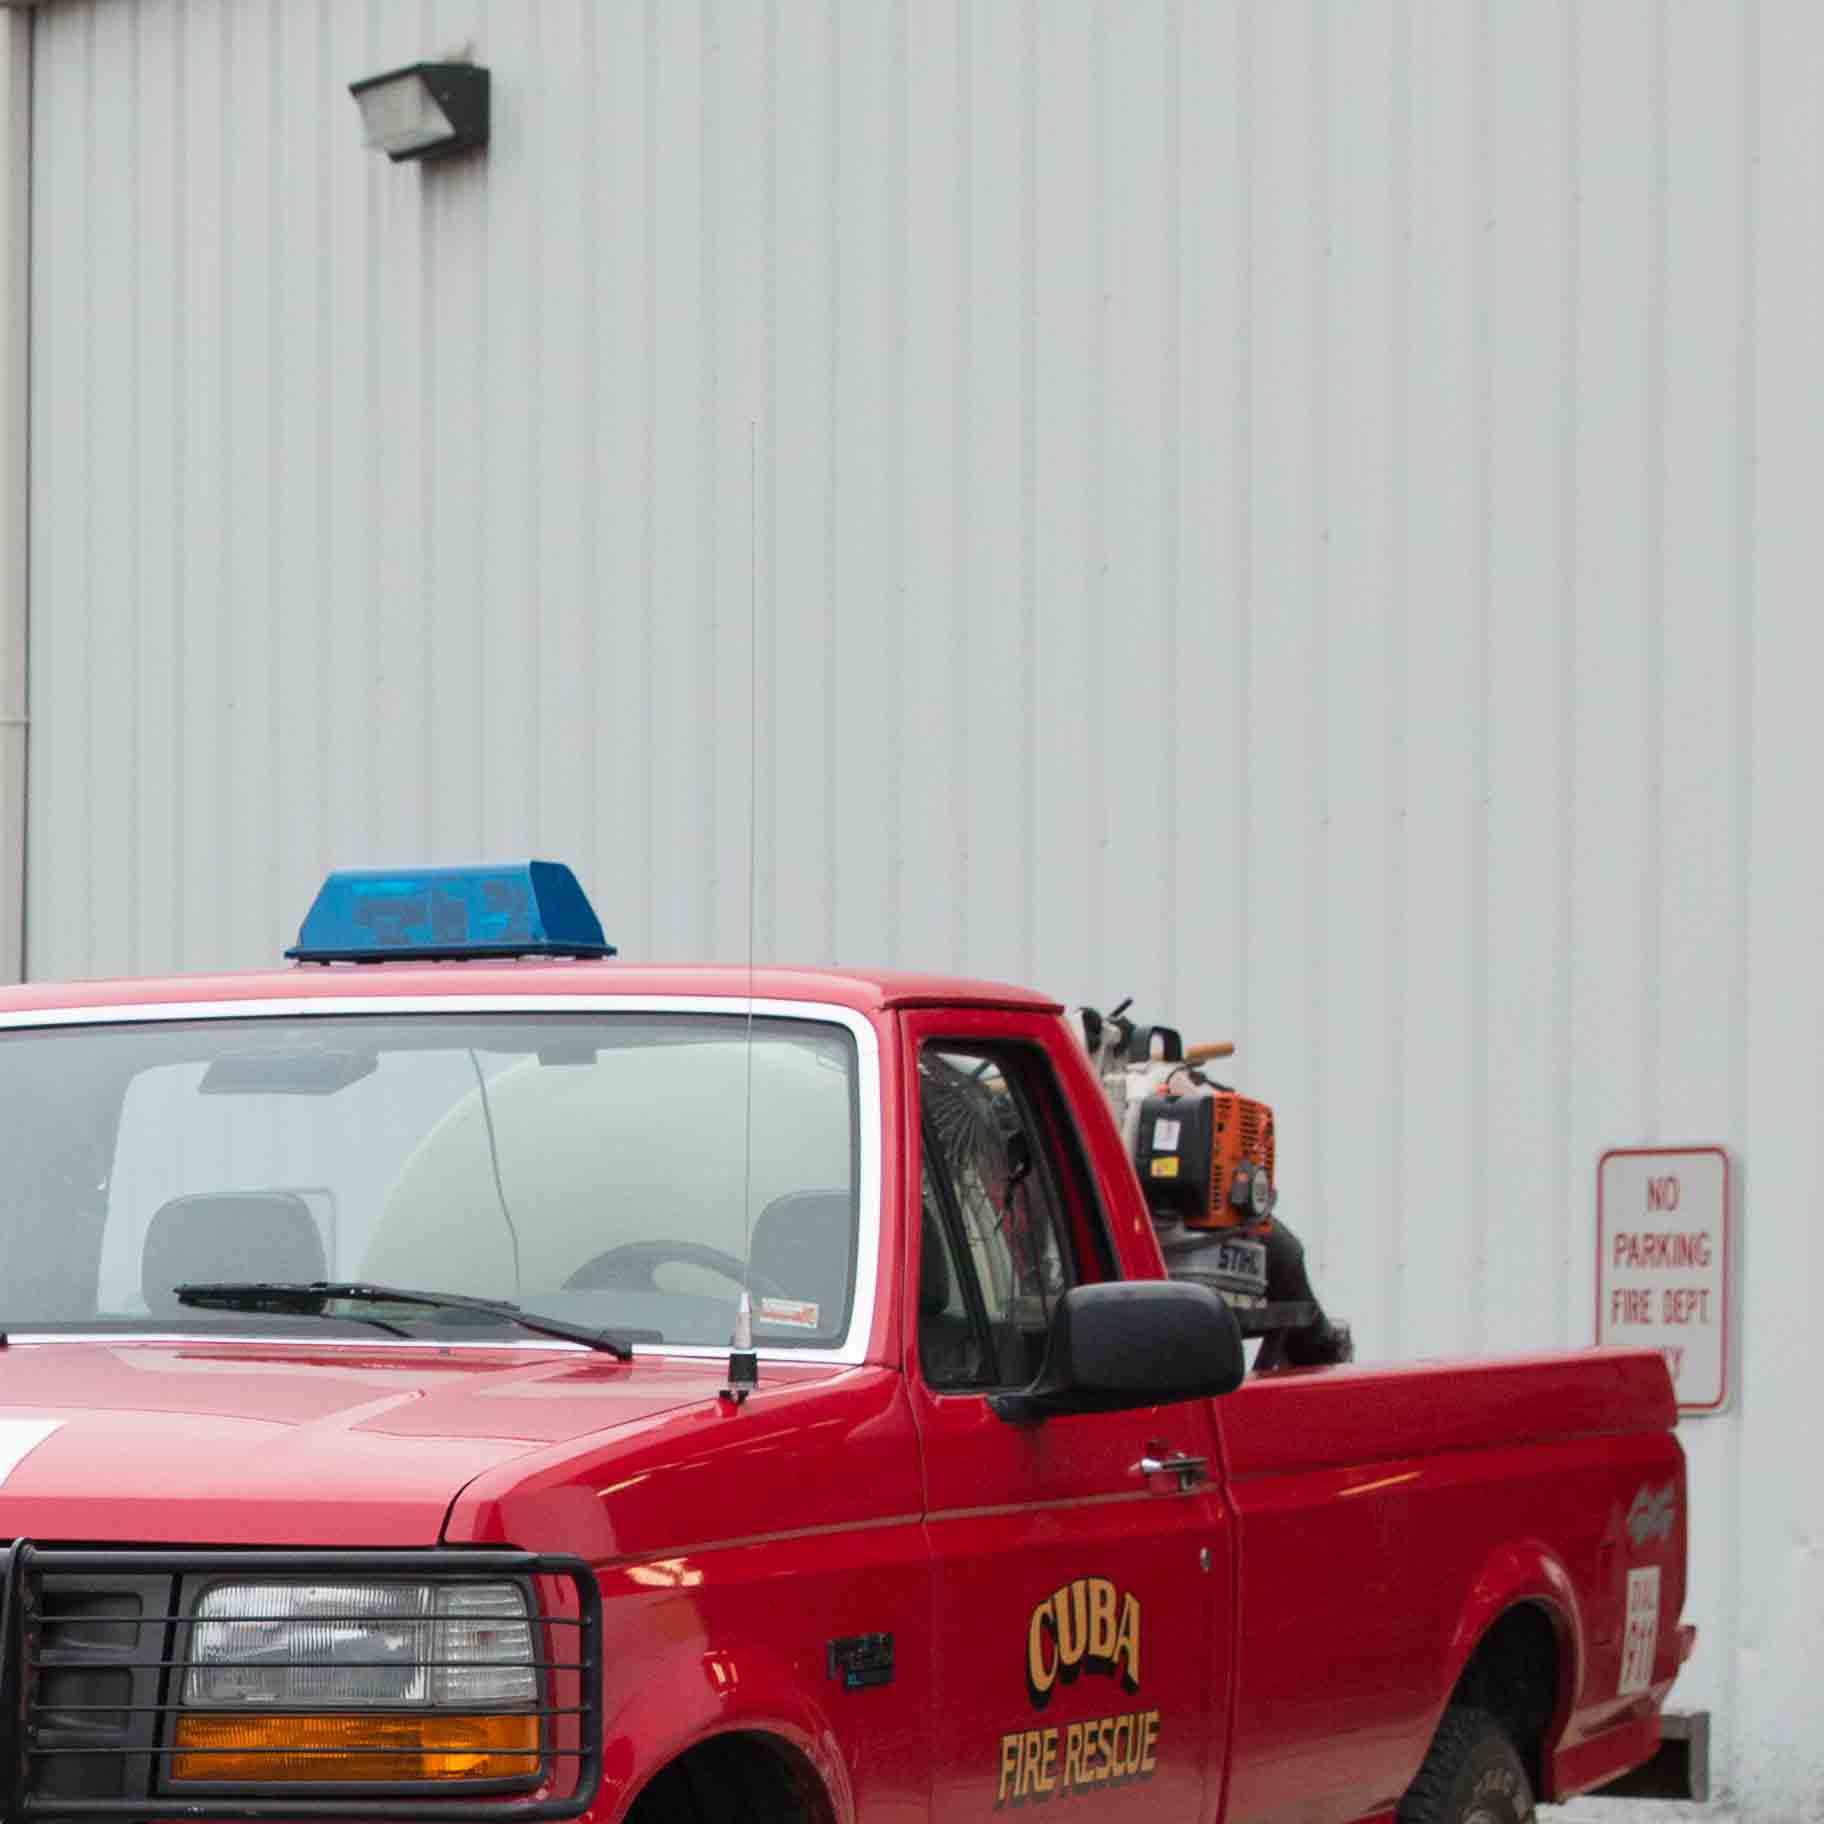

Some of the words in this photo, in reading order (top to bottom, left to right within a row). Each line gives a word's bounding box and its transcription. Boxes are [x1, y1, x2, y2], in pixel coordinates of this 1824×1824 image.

[1646, 1176, 1680, 1212] NO
[1613, 1231, 1712, 1269] PARKING
[1611, 1289, 1652, 1326] FIRE
[1663, 1288, 1711, 1325] DEPT
[1026, 1574, 1141, 1704] CUBA
[999, 1728, 1059, 1804] FIRE
[1062, 1710, 1161, 1790] RESCUE
